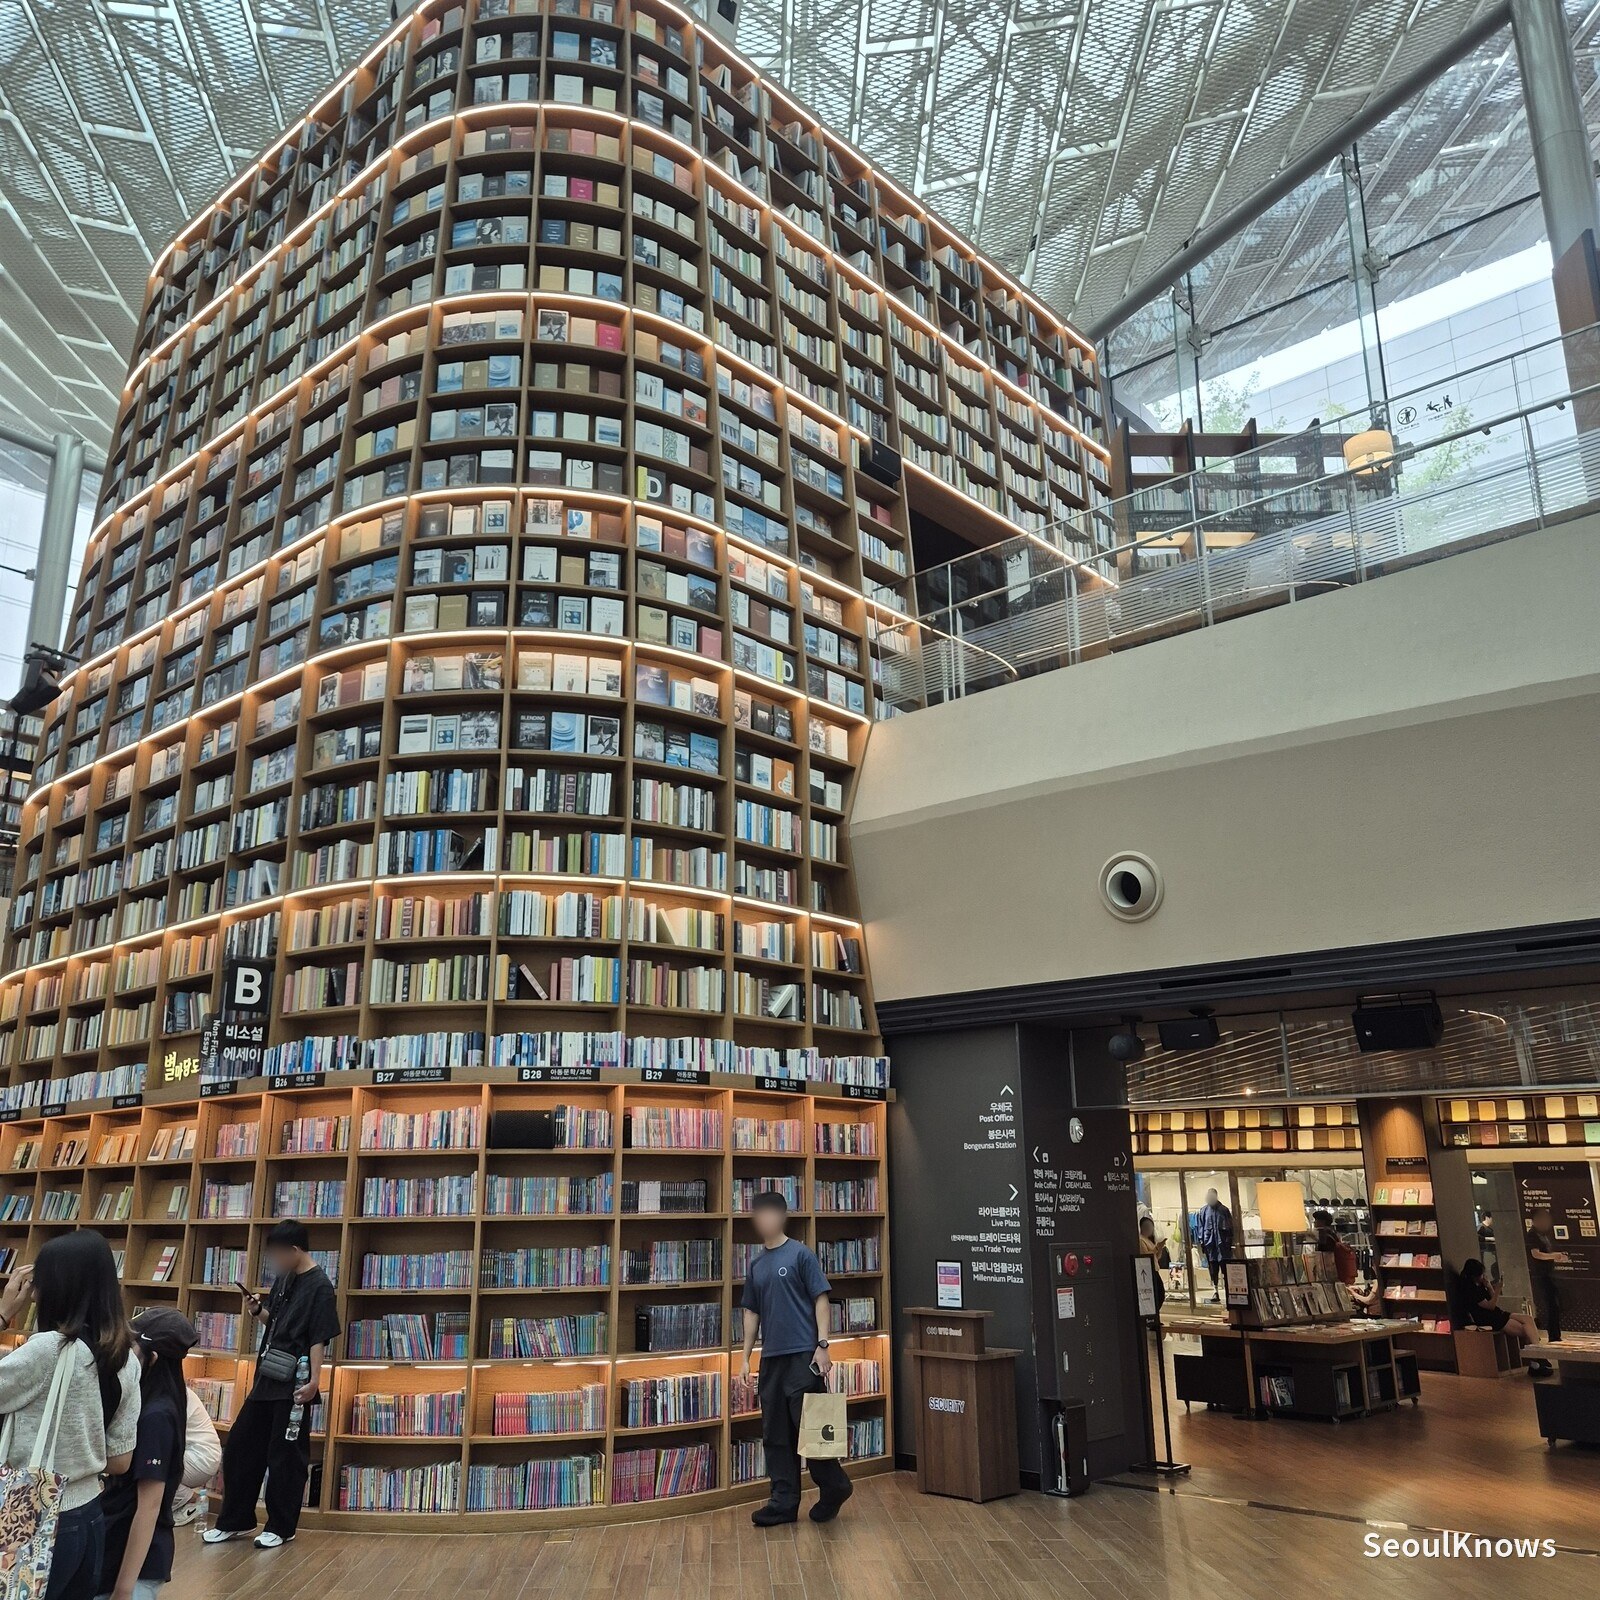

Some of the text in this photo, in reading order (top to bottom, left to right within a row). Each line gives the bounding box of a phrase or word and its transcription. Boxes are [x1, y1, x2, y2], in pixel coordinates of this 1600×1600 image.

[235, 967, 262, 1005] B
[226, 1024, 264, 1042] 비소설
[200, 1030, 212, 1057] Essay
[222, 1047, 262, 1063] 에세이
[376, 1072, 395, 1083] B27
[522, 1069, 542, 1080] B28
[646, 1070, 662, 1080] B29
[274, 1078, 288, 1088] B26
[764, 1078, 778, 1088] B30
[202, 1086, 212, 1096] B25
[850, 1086, 860, 1096] B31
[990, 1102, 1013, 1112] 우체국
[979, 1114, 1014, 1122] Post Office
[988, 1129, 1016, 1140] 봉은사역
[995, 1141, 1017, 1149] Station
[1044, 1181, 1058, 1190] Coffee
[978, 1206, 1020, 1218] 라이브플라자
[991, 1219, 1020, 1228] Live Plaza
[979, 1232, 1021, 1244] 트레이드타워
[984, 1244, 1002, 1253] Trade
[1002, 1245, 1022, 1254] Tower
[971, 1261, 1024, 1274] 밀레니엄플라자
[972, 1274, 1024, 1284] Millennium Plaza
[928, 1396, 966, 1414] SECURITY
